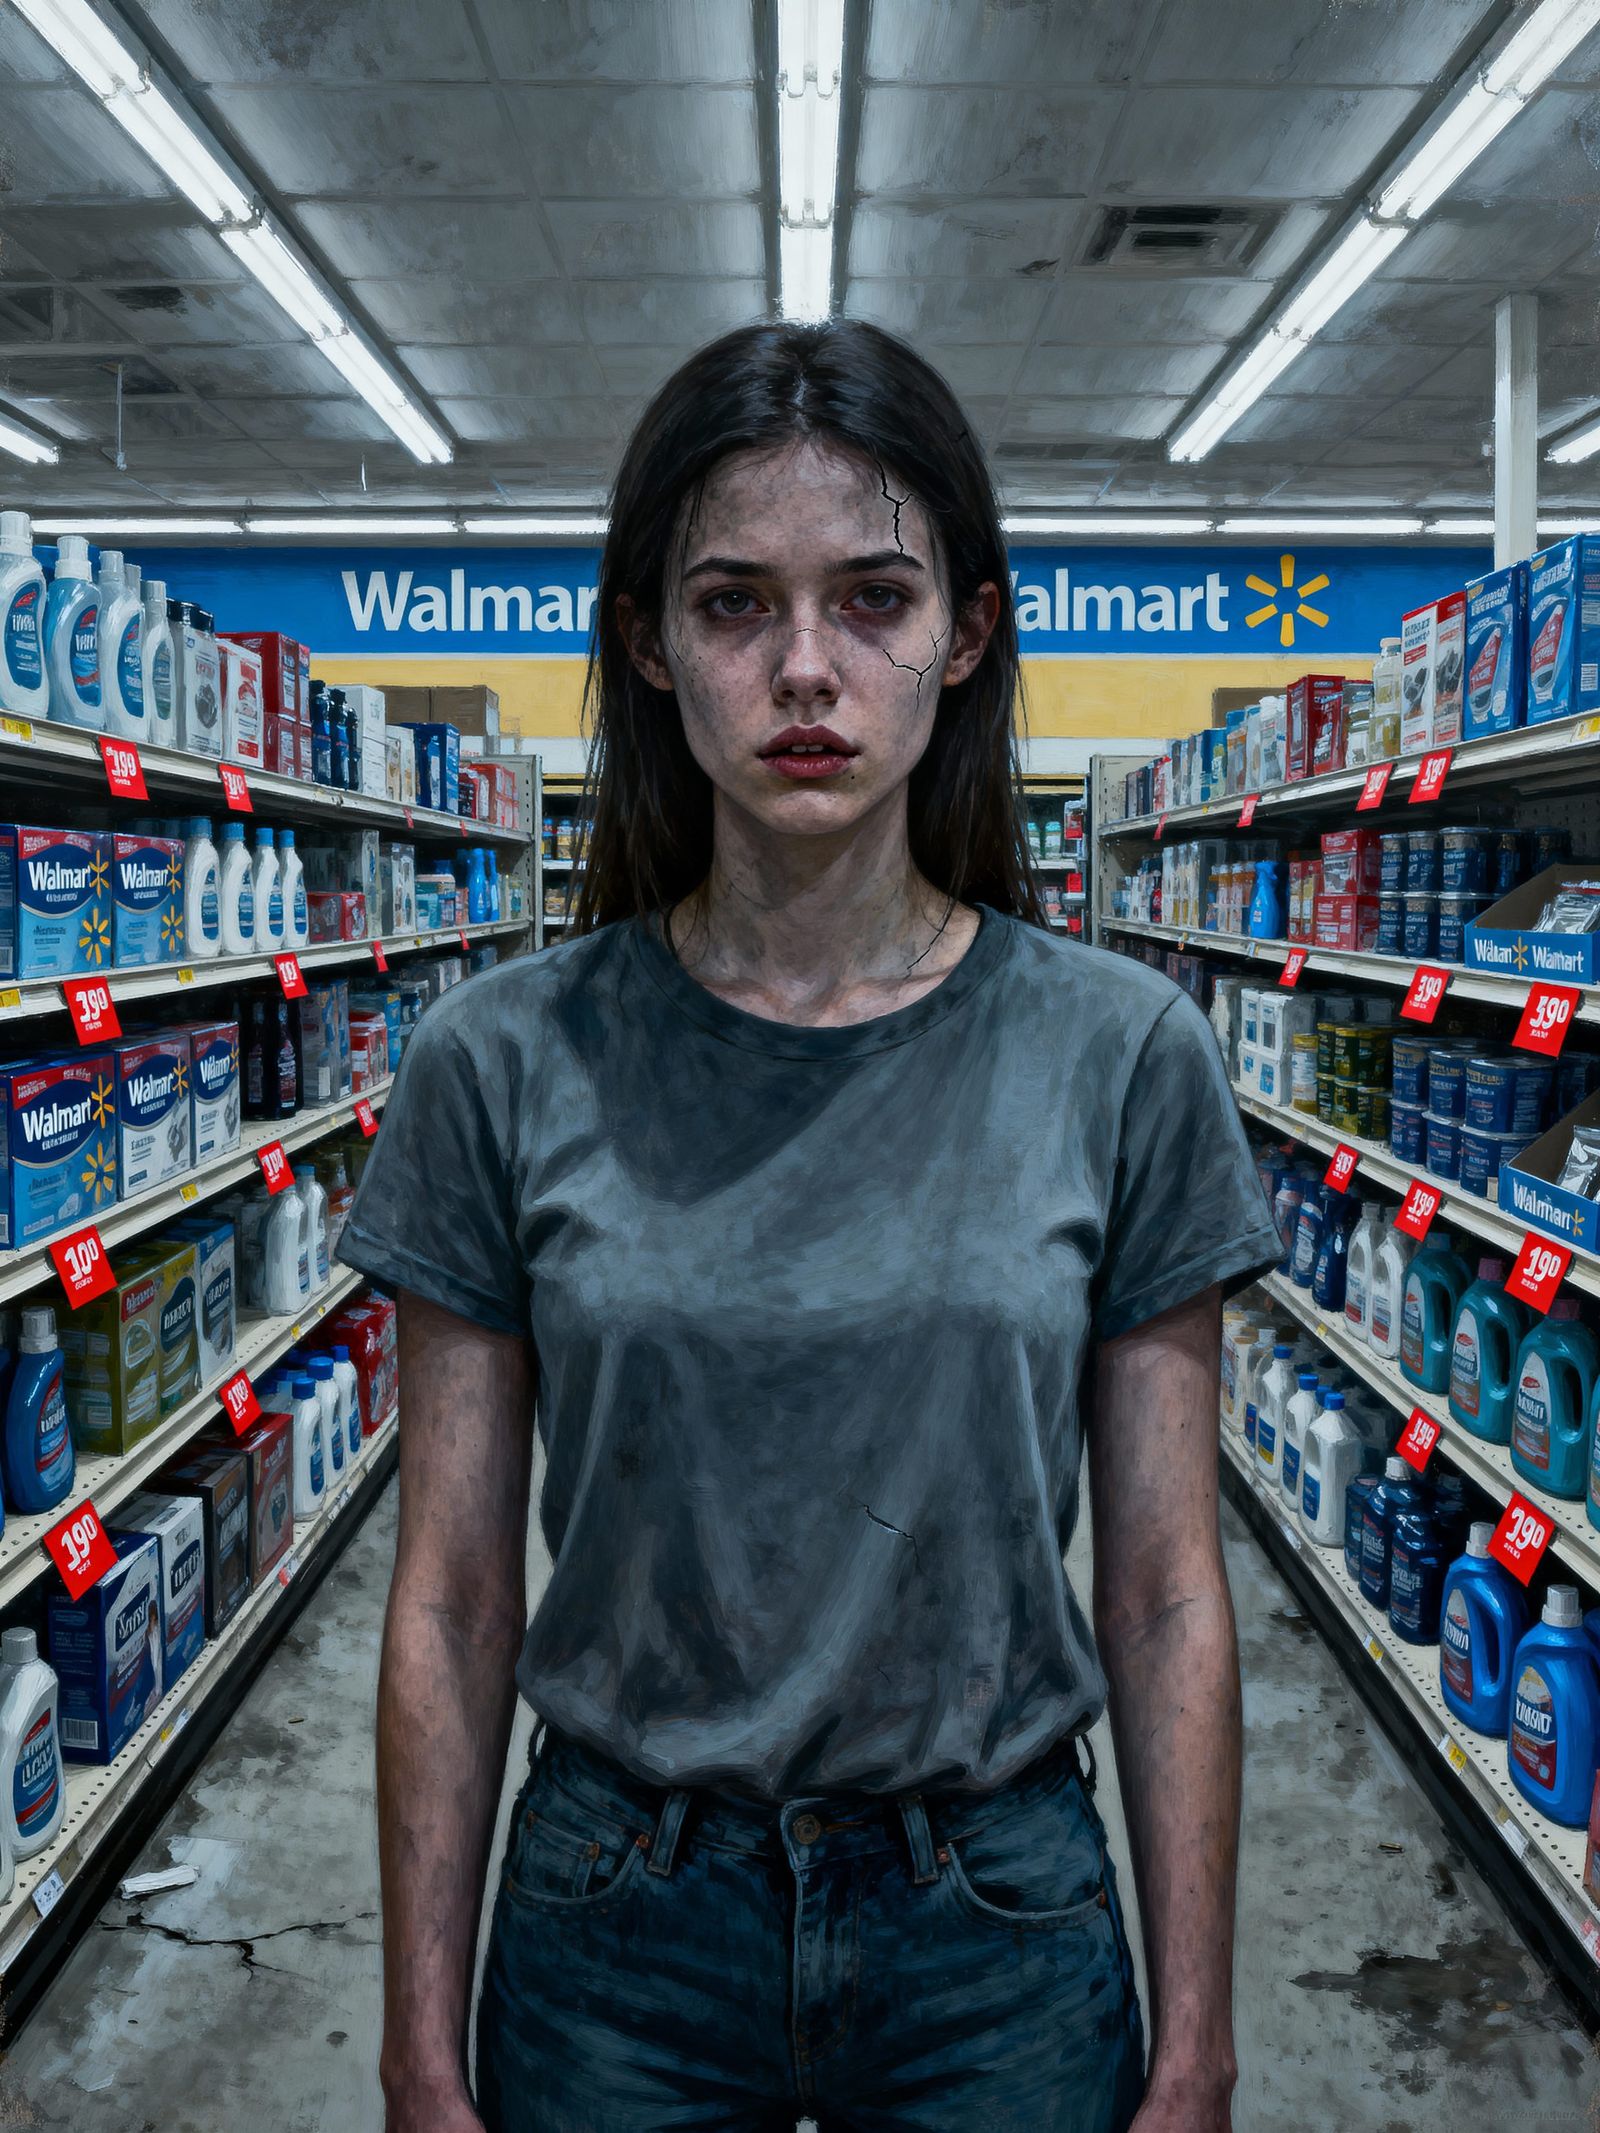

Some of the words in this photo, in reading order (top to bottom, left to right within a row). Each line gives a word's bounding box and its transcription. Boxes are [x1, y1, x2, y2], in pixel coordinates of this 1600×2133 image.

[341, 568, 600, 632] Walmar
[1009, 568, 1229, 632] almart
[1529, 995, 1570, 1029] 590
[64, 1237, 99, 1283] 100
[1523, 1246, 1562, 1282] 190
[61, 1513, 98, 1571] 190
